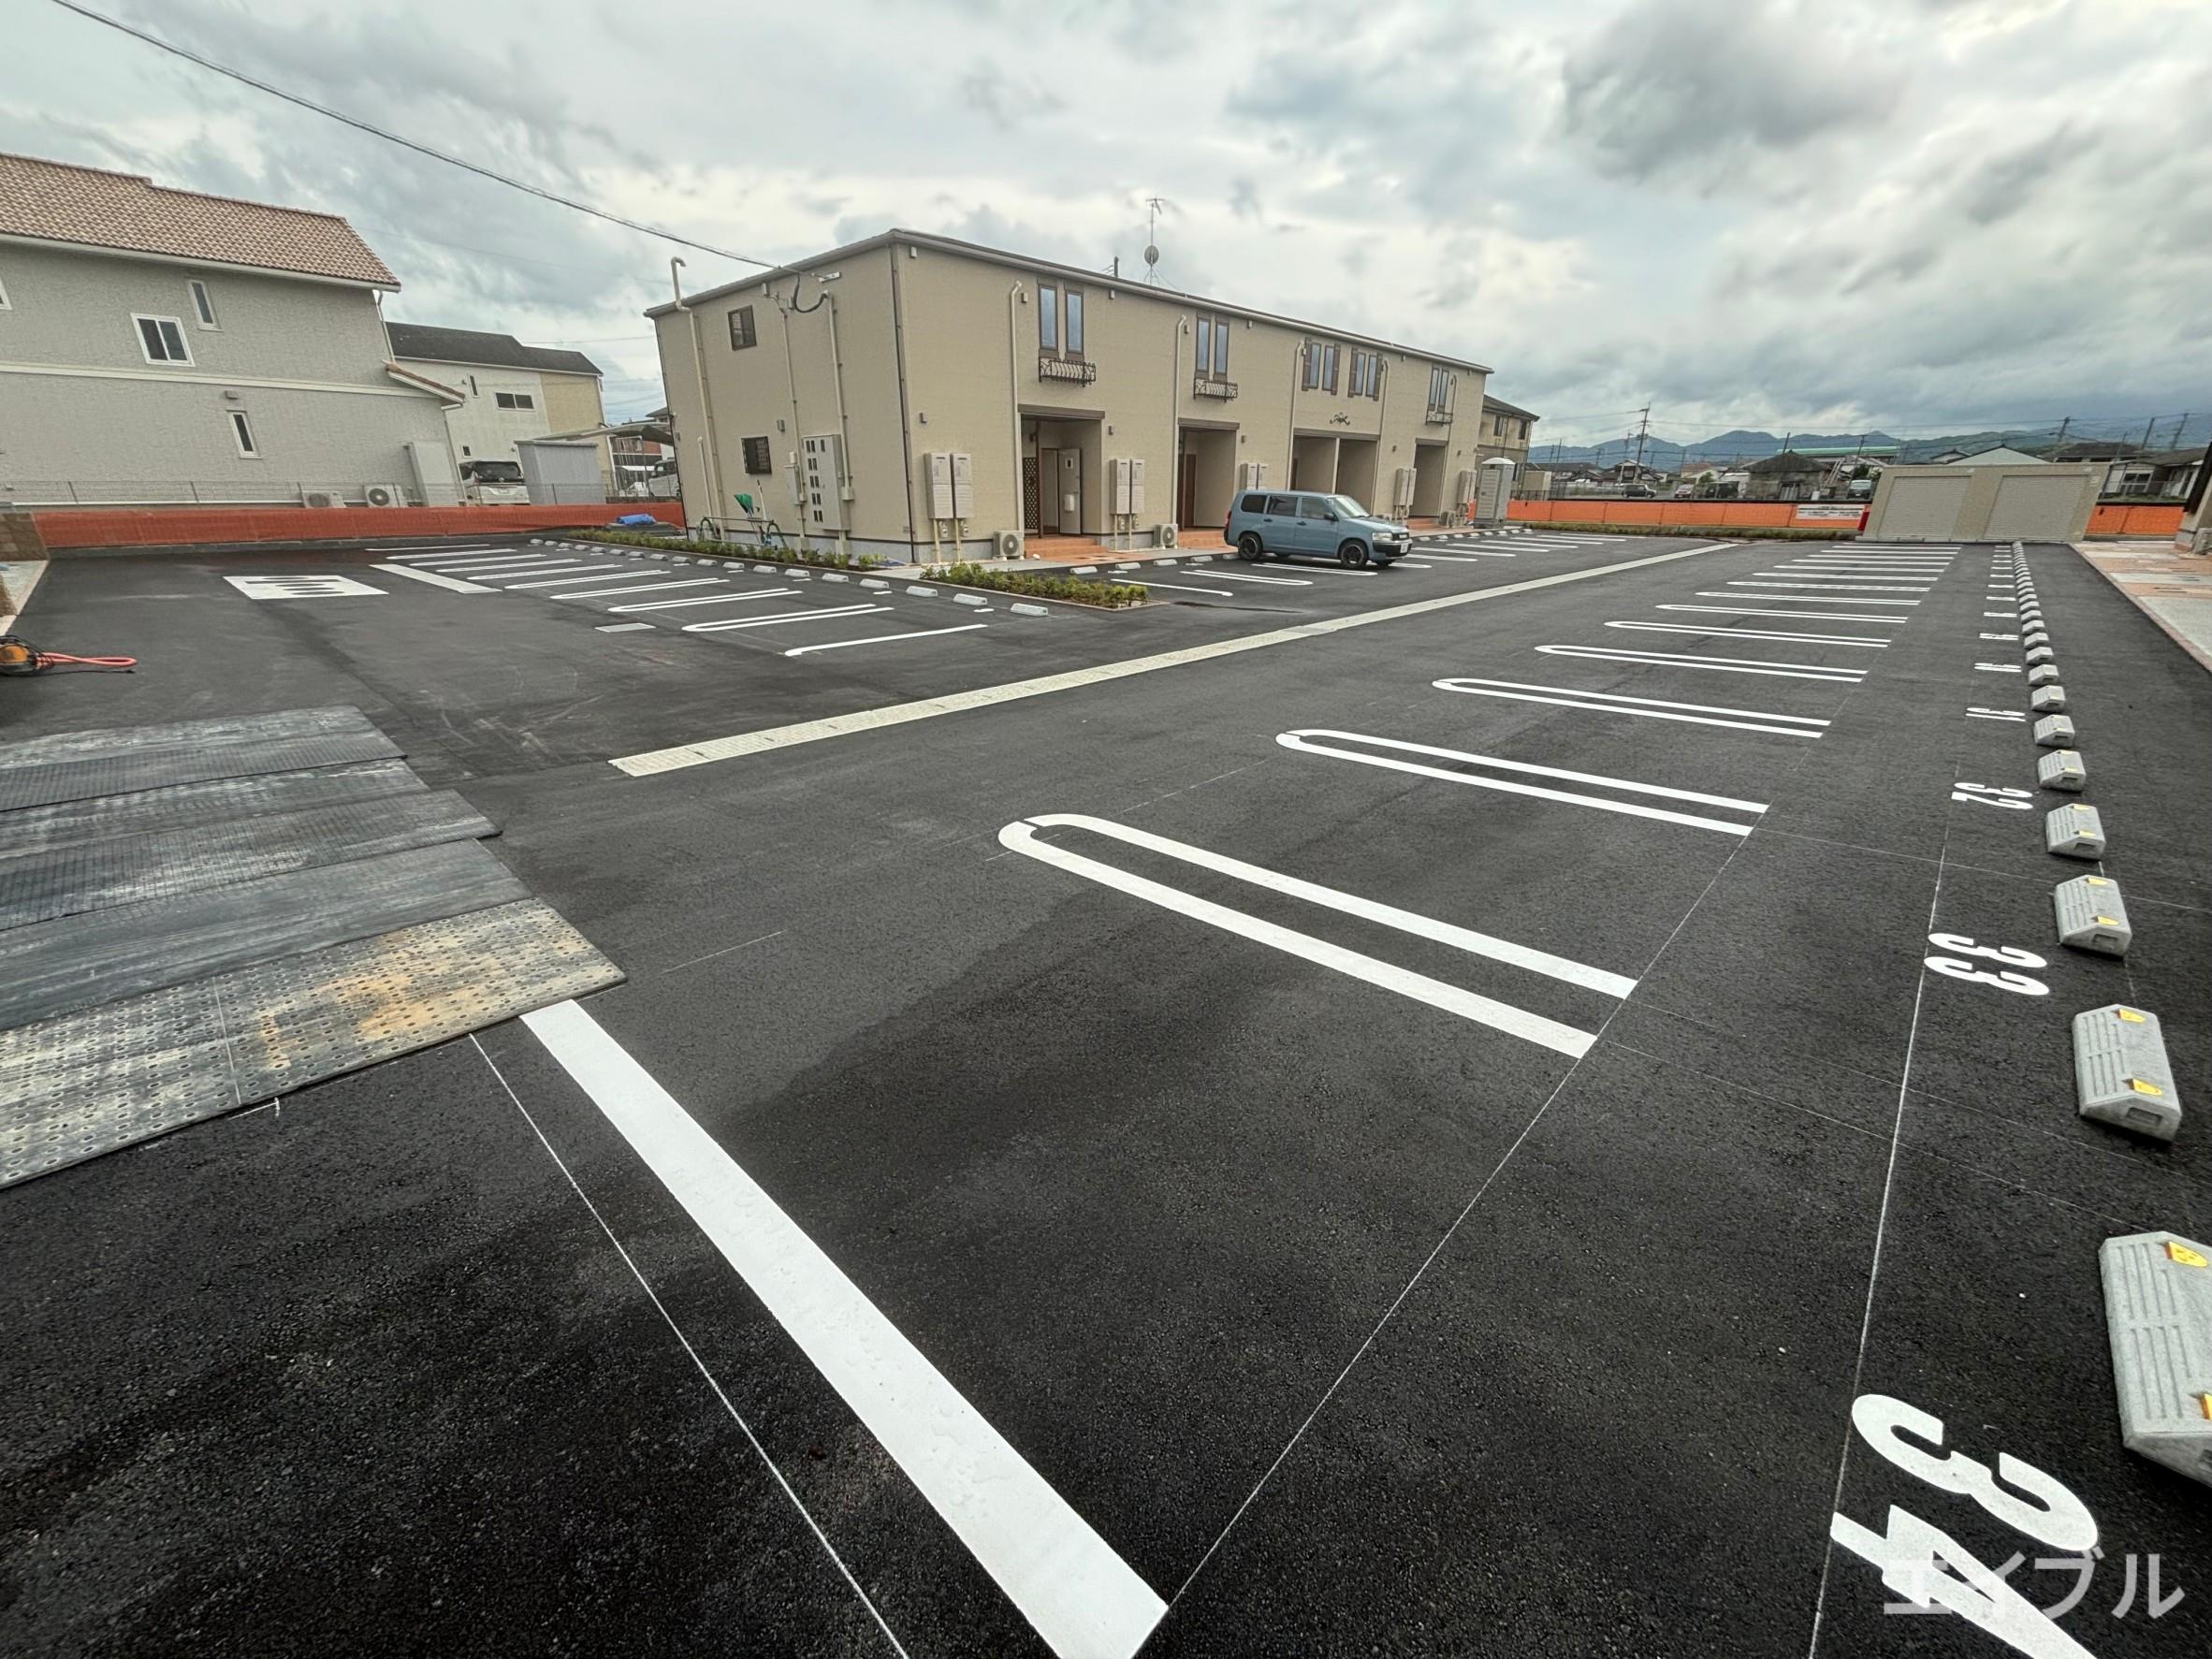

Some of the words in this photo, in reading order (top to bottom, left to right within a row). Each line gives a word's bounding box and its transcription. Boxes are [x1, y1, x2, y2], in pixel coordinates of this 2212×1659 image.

[1965, 707, 2026, 721] 31
[1951, 782, 2033, 809] 32
[1924, 933, 2050, 996] 33
[1829, 1393, 2099, 1659] 34
